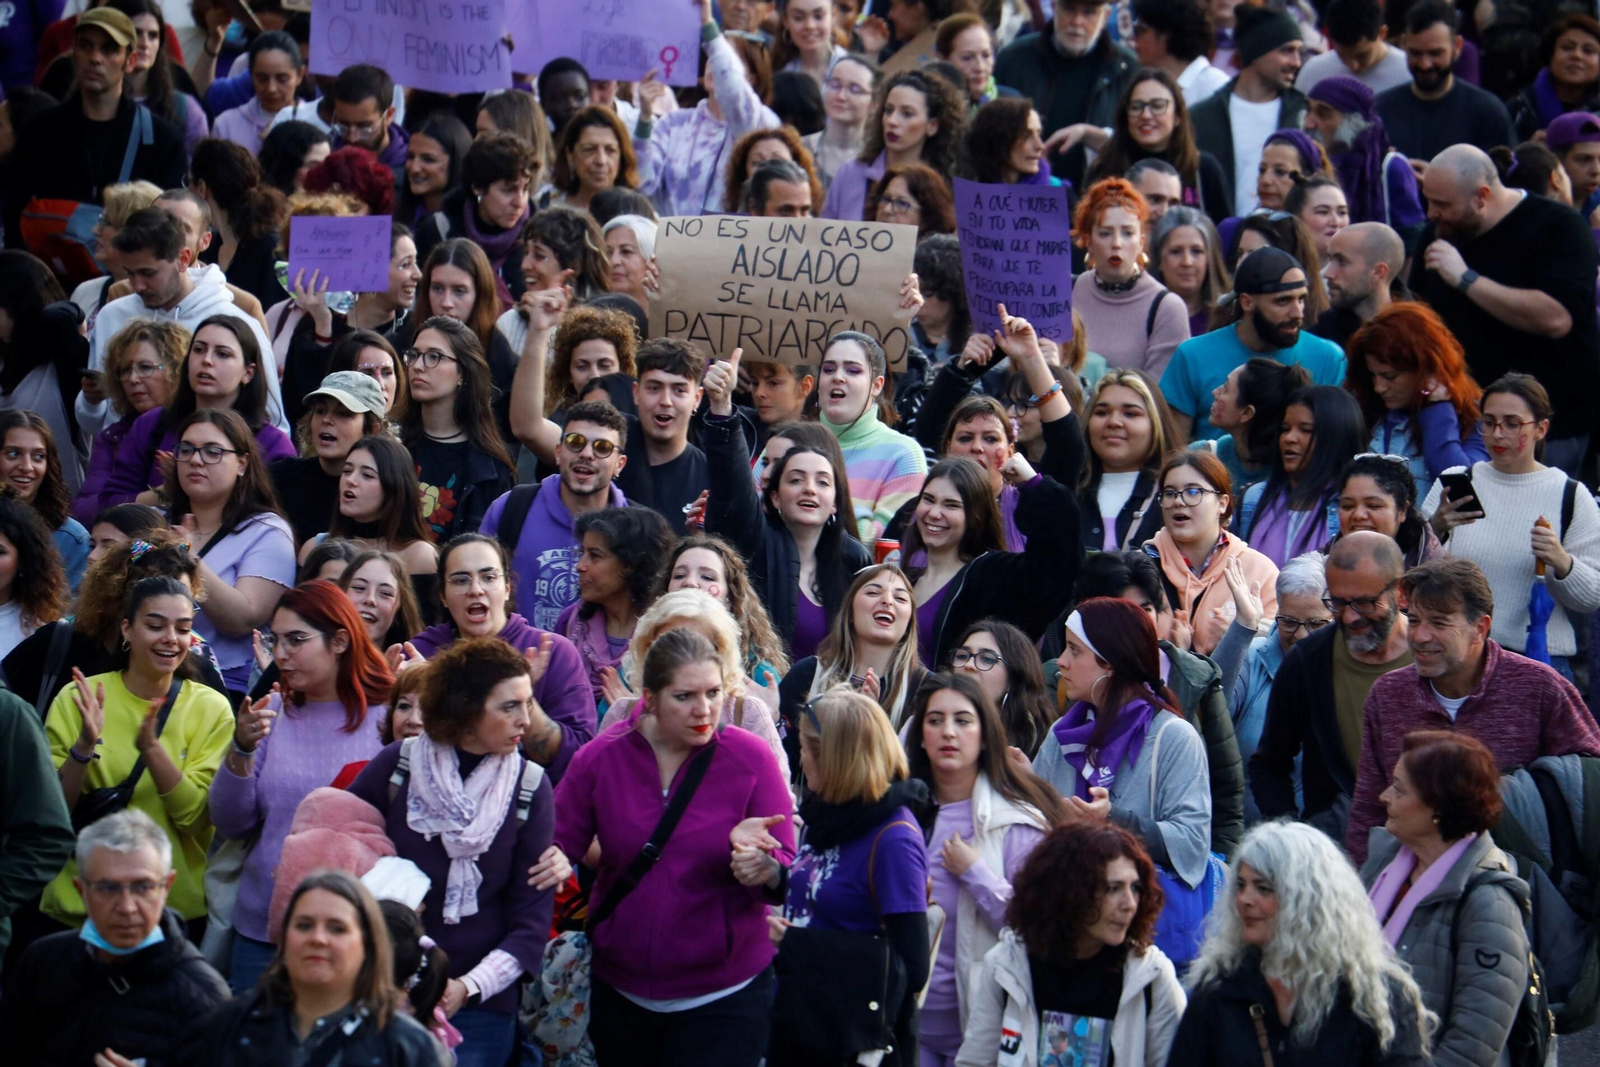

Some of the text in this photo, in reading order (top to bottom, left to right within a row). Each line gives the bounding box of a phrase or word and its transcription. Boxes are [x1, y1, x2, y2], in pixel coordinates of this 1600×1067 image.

[438, 4, 453, 20] IS
[461, 5, 490, 22] THE
[403, 32, 501, 77] FEMINISM
[974, 193, 983, 210] A
[1018, 197, 1059, 213] MUJER
[988, 215, 1006, 230] TU
[1012, 216, 1041, 231] VIDA
[665, 218, 894, 252] NO ES UN CASO
[1011, 240, 1031, 254] QUE
[1035, 240, 1069, 255] MATAR
[731, 243, 861, 287] AISLADO
[972, 252, 1043, 275] PARA QUE TE
[717, 281, 848, 315] SE LLAMA
[1041, 284, 1057, 297] LA
[1029, 299, 1072, 319] CONTRA
[535, 580, 548, 597] 19
